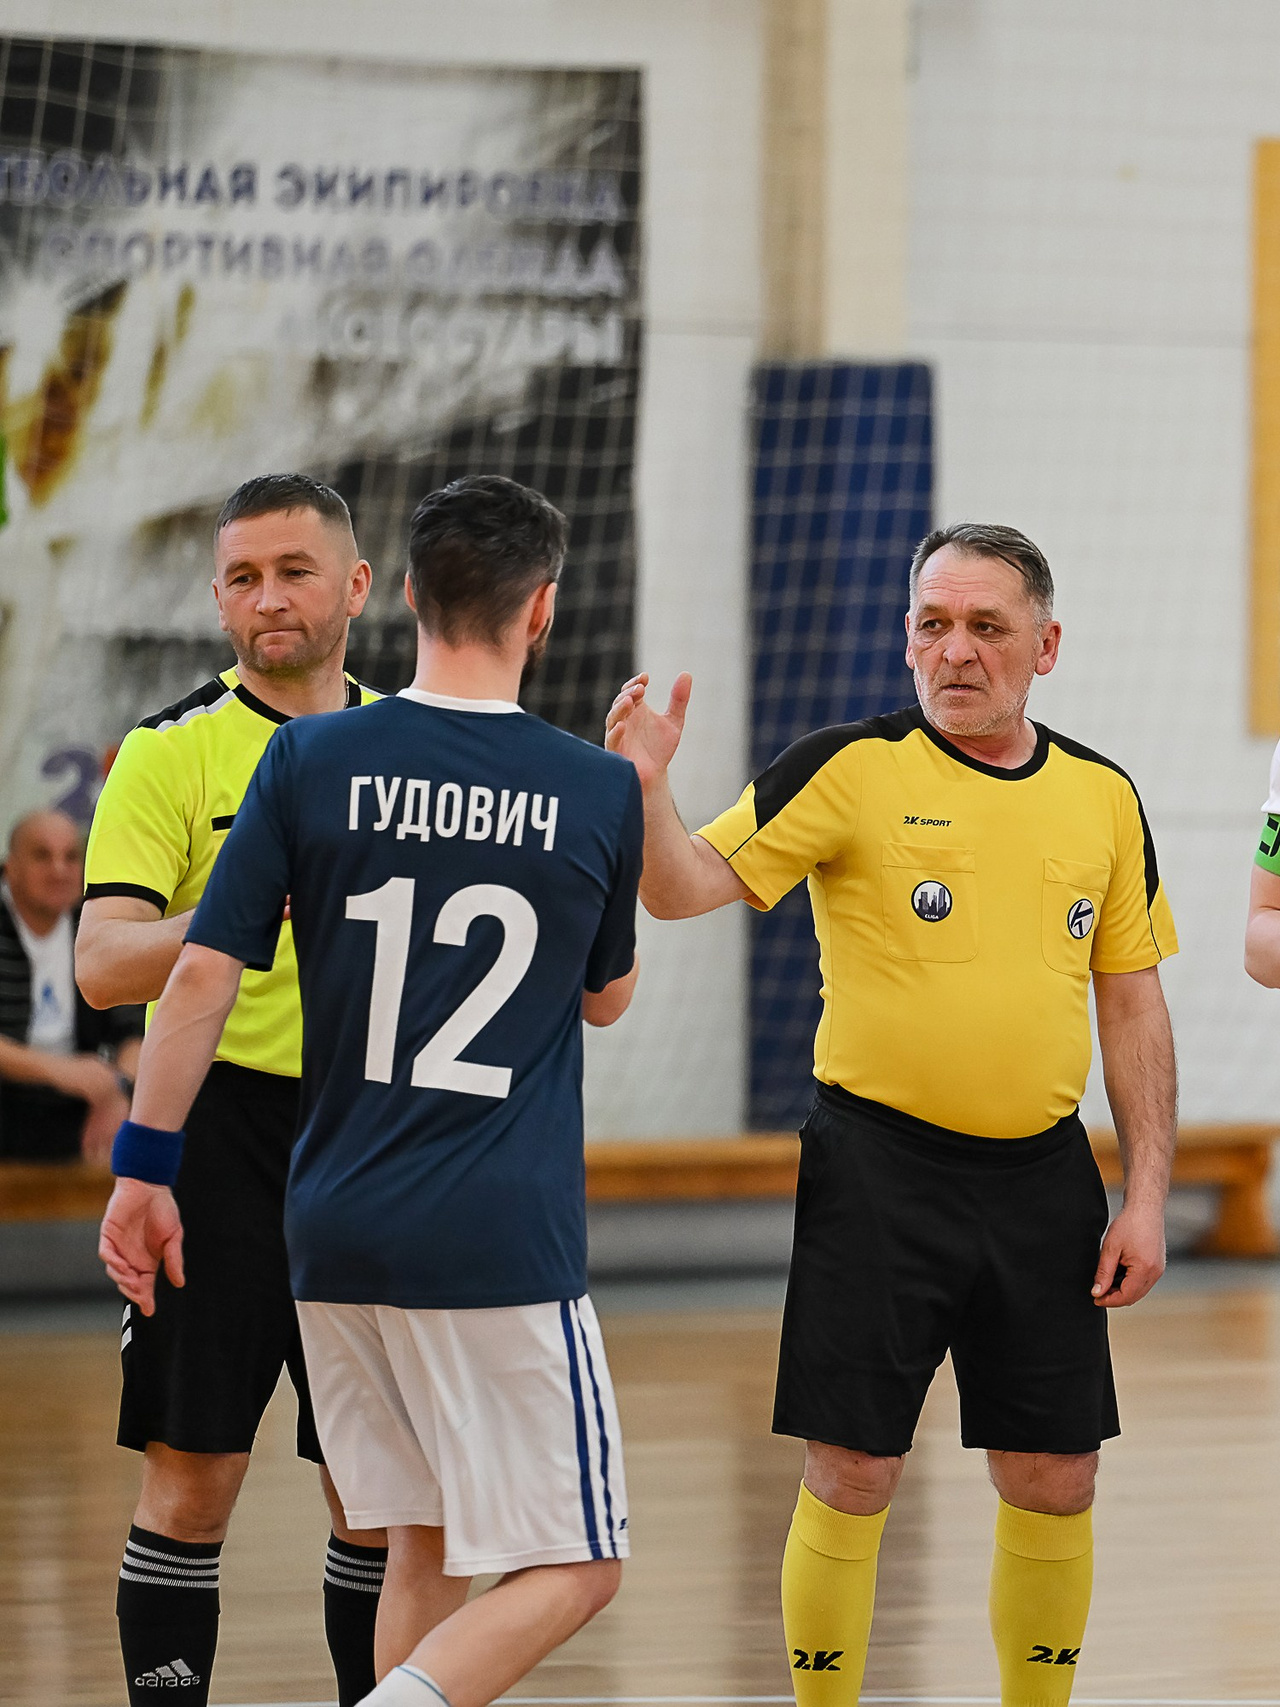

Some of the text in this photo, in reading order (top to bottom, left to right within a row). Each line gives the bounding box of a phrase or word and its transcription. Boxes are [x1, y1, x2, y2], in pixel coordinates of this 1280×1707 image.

[348, 775, 559, 851] ГУДОВИЧ
[920, 818, 952, 827] SPORT
[345, 877, 539, 1098] 12
[793, 1648, 844, 1671] 2K
[1026, 1644, 1081, 1665] 2K
[135, 1675, 200, 1688] adidas
